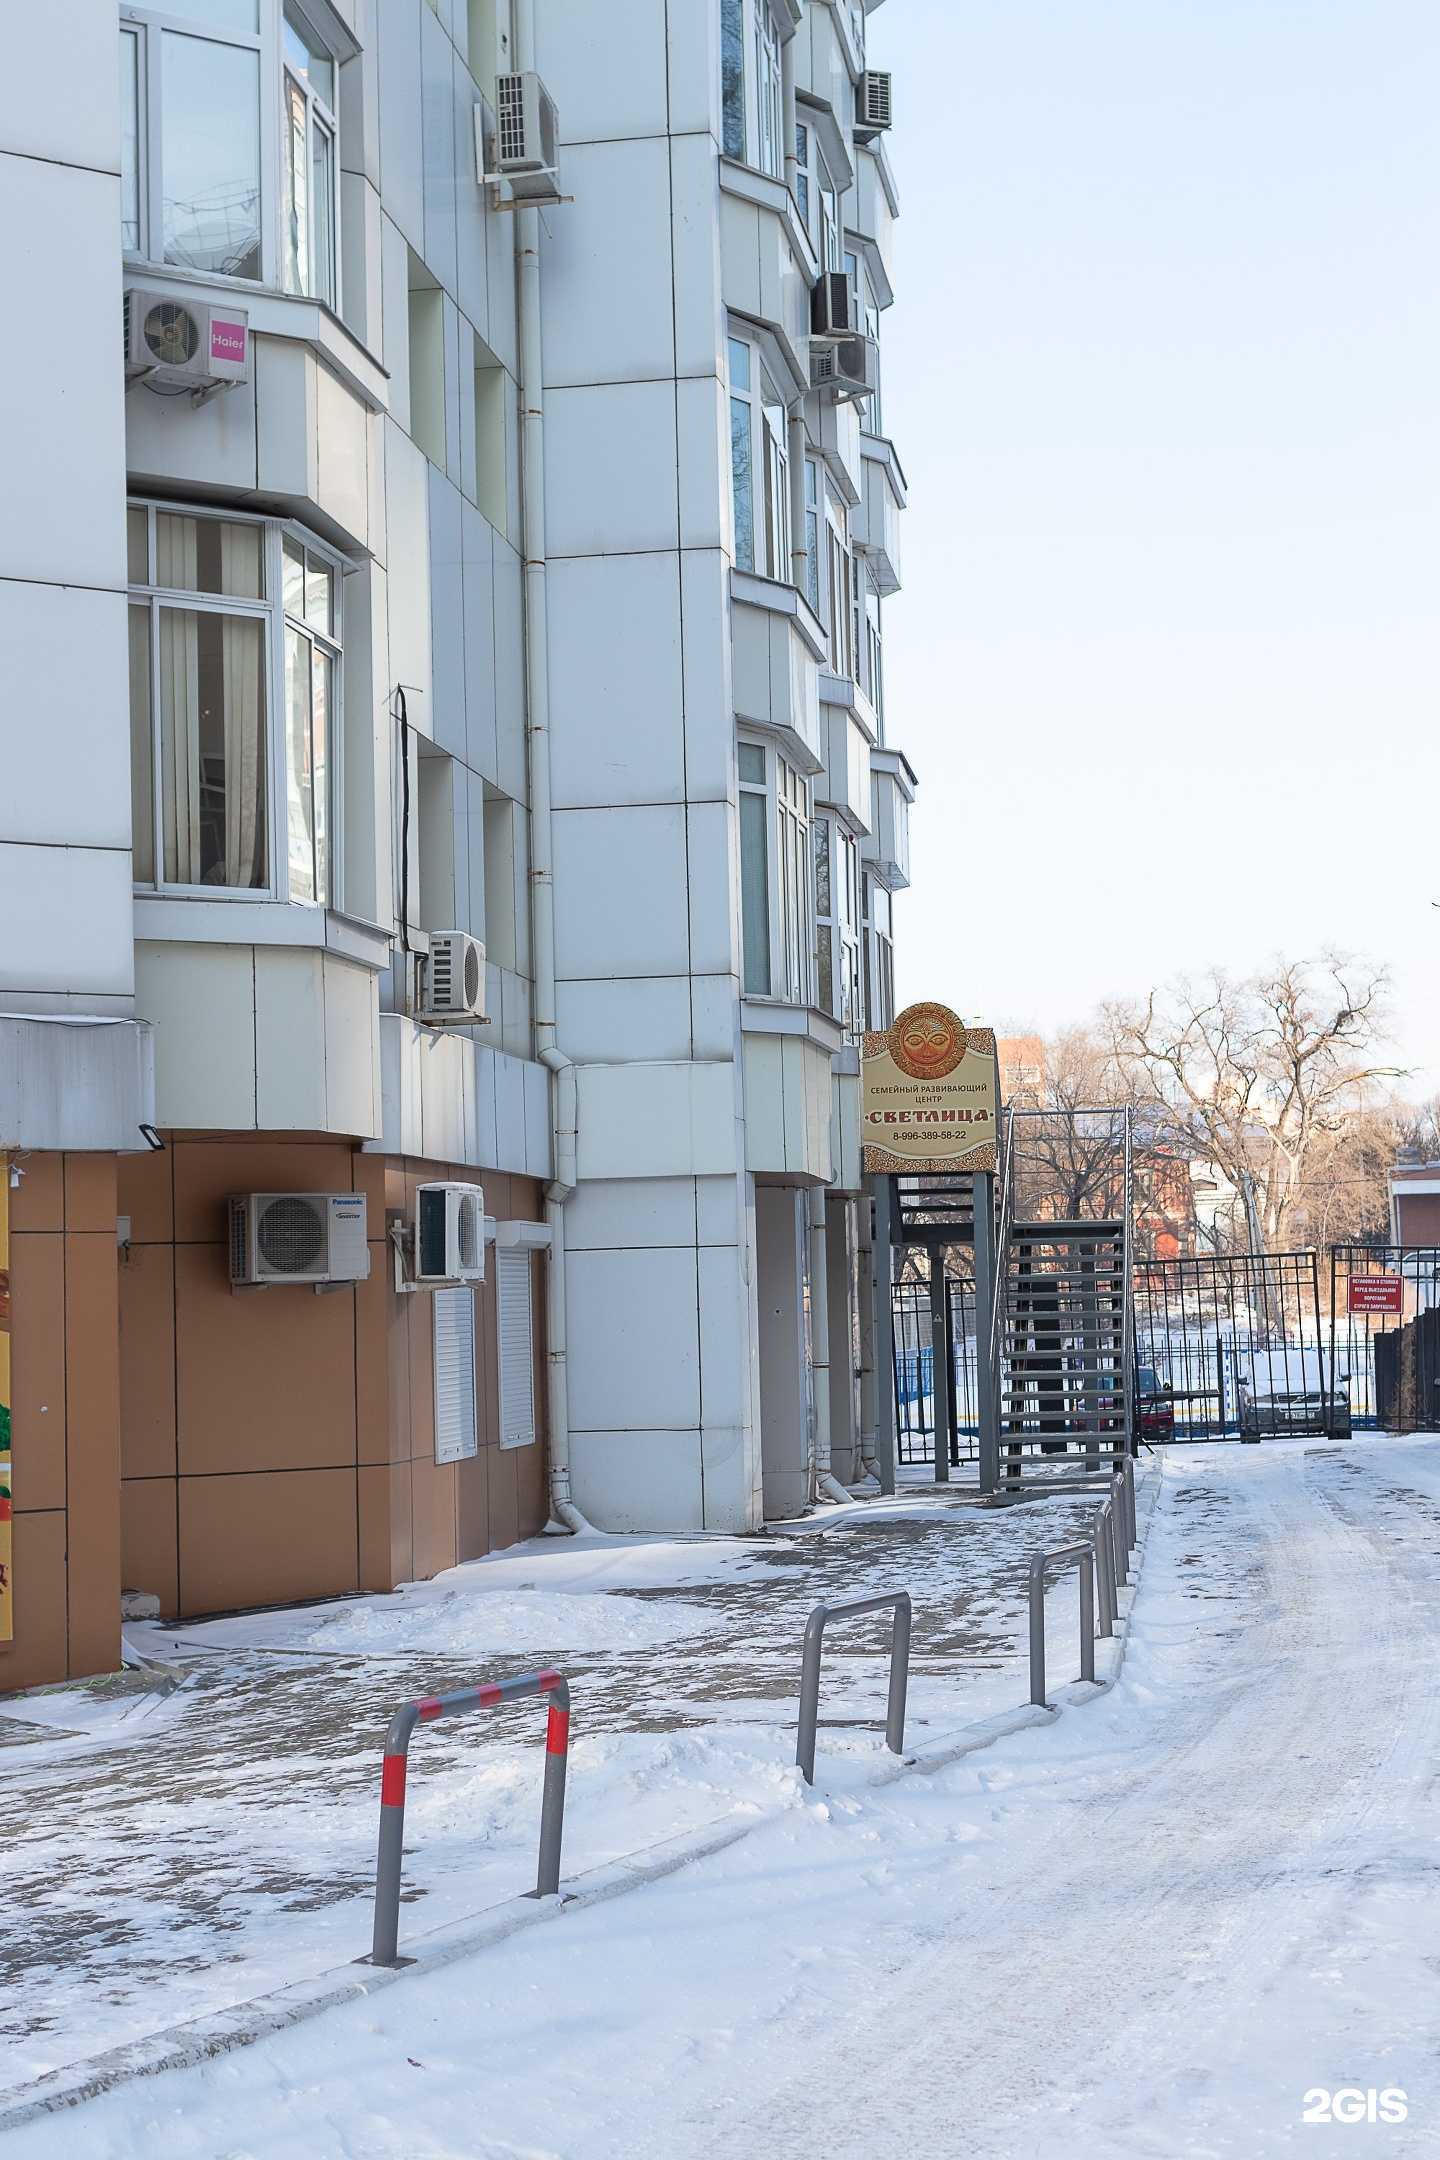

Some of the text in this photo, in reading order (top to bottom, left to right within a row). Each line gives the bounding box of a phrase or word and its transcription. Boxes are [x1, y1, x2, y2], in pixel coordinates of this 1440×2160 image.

[212, 334, 243, 349] Haier
[870, 1083, 987, 1094] СЕМЕЙНЫЙ РАЗВИВАЮЩИЙ
[915, 1096, 942, 1104] ЦЕНТР
[869, 1109, 989, 1123] СВЕТЛИЦА
[893, 1130, 967, 1140] 8-996-389-58-22
